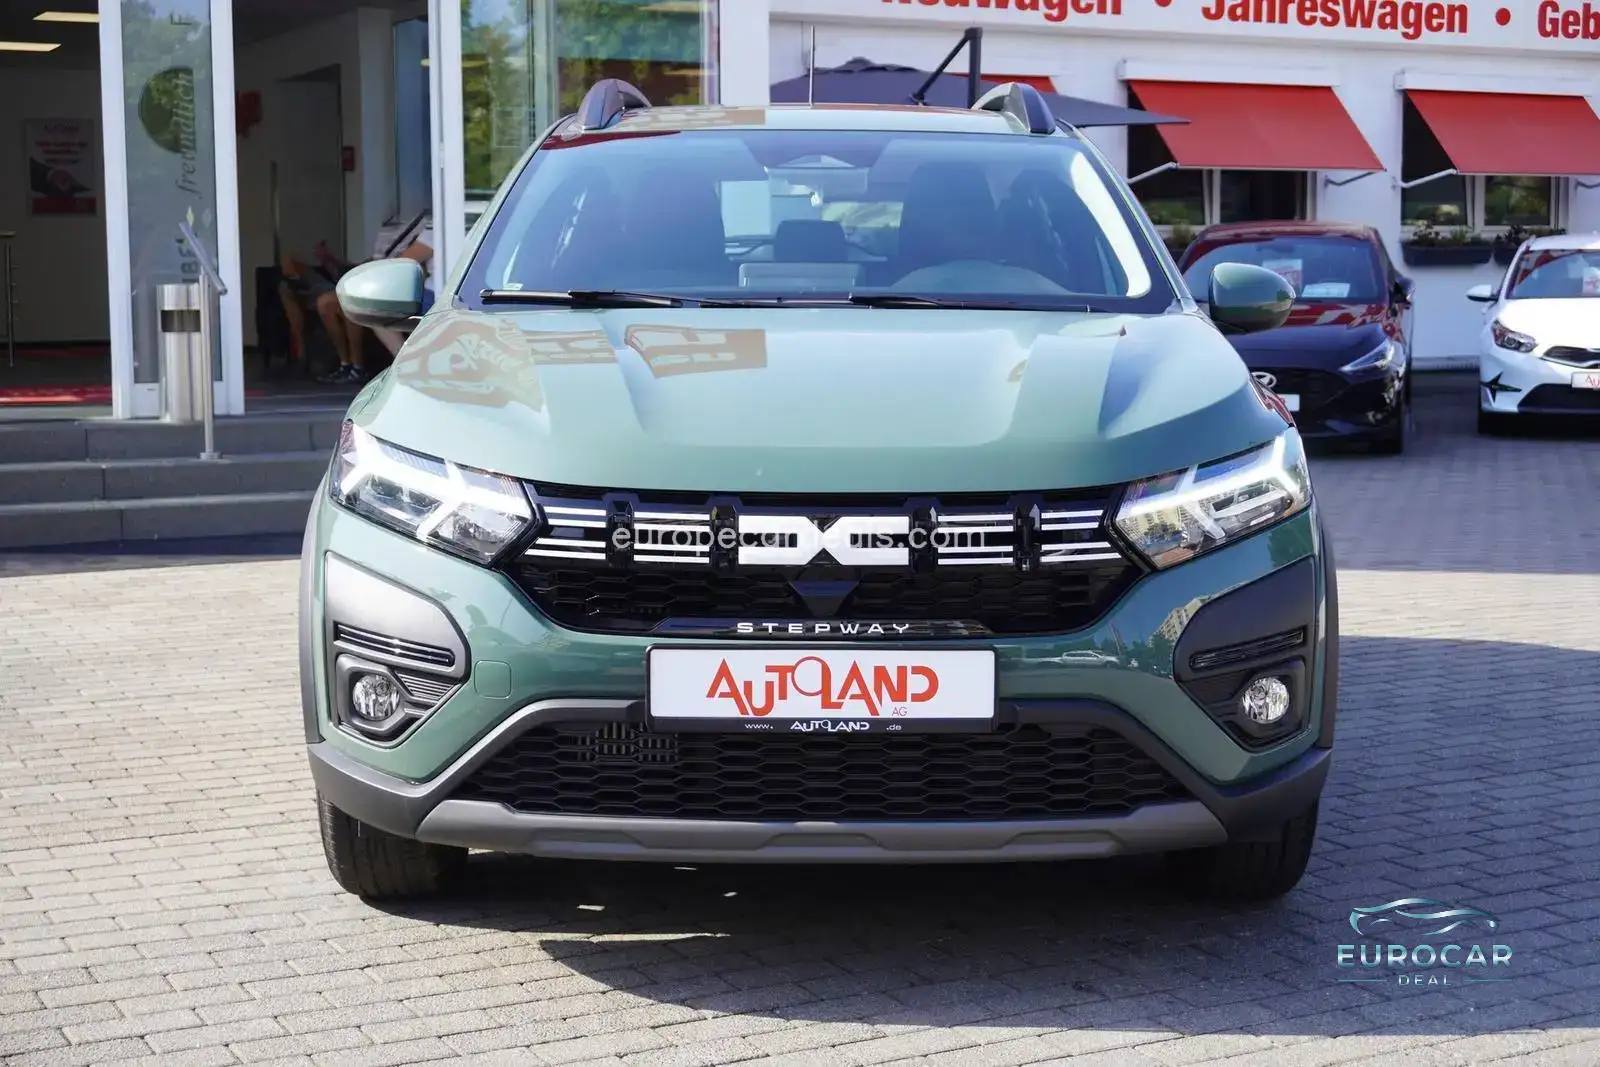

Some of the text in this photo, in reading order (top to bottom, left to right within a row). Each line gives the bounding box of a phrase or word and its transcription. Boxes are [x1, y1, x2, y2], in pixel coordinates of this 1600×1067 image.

[1201, 0, 1467, 40] Jahreswagen
[173, 73, 203, 199] freundlich
[737, 622, 909, 634] STEPWAY
[706, 656, 939, 717] AUTOLAND
[891, 706, 908, 717] AG
[790, 719, 870, 732] AUTOLAND
